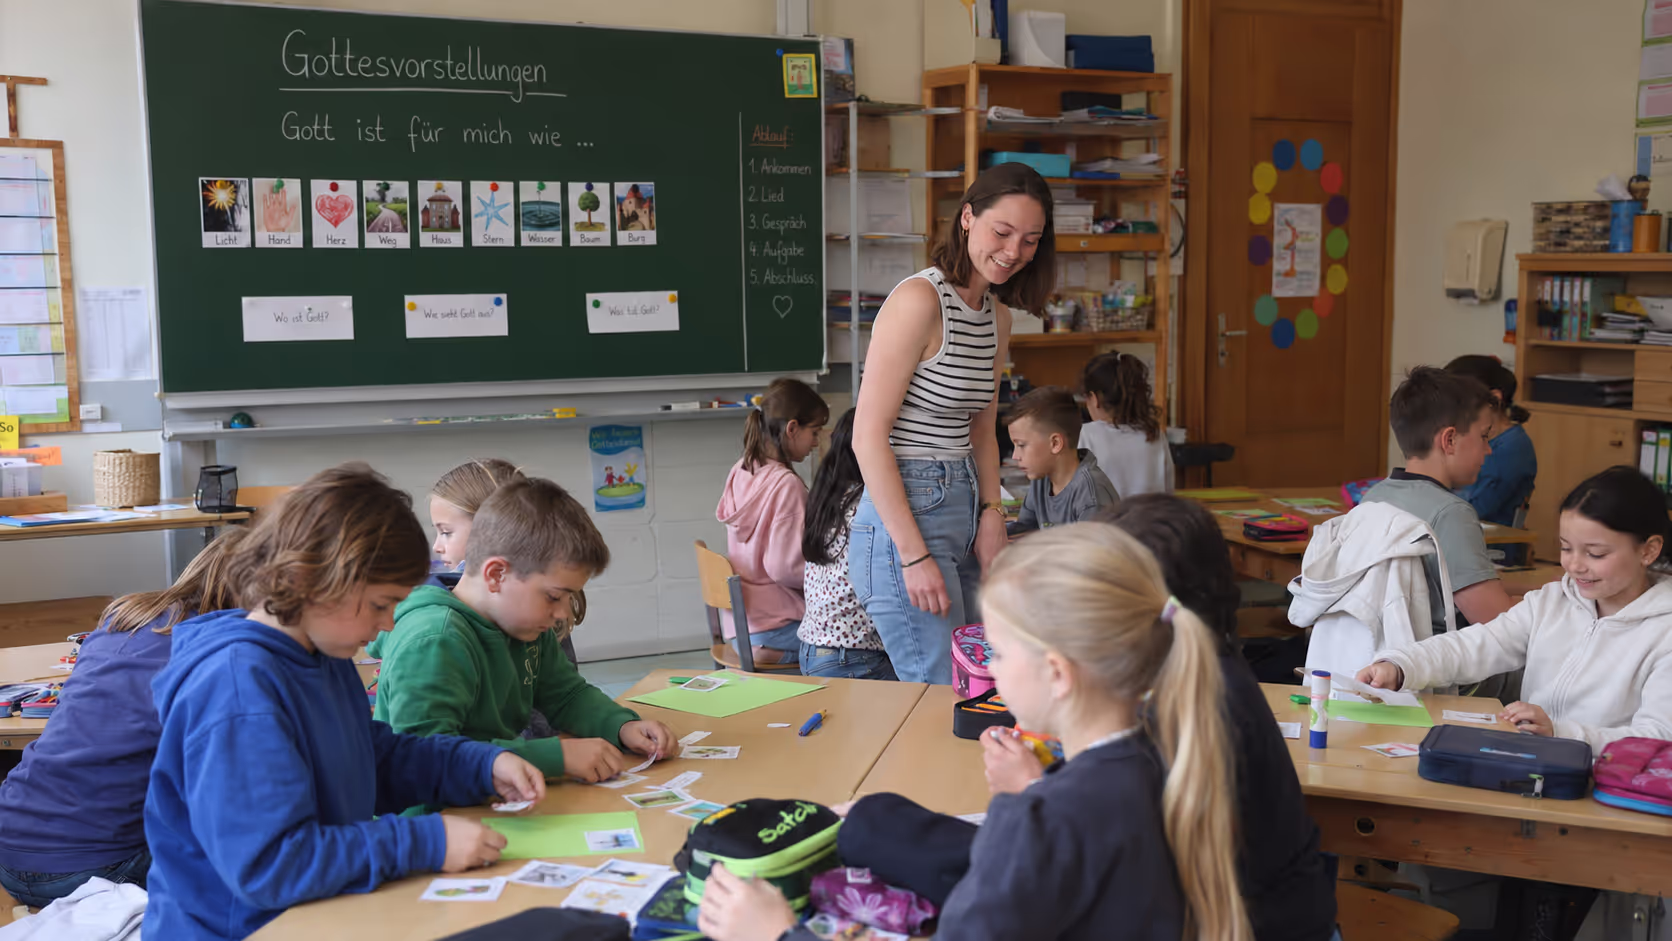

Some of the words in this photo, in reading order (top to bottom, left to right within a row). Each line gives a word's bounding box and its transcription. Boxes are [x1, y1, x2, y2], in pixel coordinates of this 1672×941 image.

[282, 29, 547, 103] Gottesvorstellungen
[281, 110, 336, 142] Gott
[356, 114, 387, 142] ist
[407, 115, 444, 152] für
[463, 115, 512, 145] mich
[528, 125, 562, 147] wie
[748, 157, 758, 174] 1.
[760, 157, 812, 175] Ankommen
[748, 186, 759, 202] 2.
[761, 185, 785, 203] Lied
[748, 213, 759, 230] 3.
[762, 213, 807, 236] Gespräch
[215, 234, 238, 246] Licht
[268, 234, 291, 245] Hand
[326, 234, 347, 245] Herz
[378, 235, 398, 248] Weg
[482, 234, 504, 245] Stern
[627, 233, 646, 245] Burg
[749, 241, 760, 257] 4.
[763, 240, 805, 265] Aufgabe
[750, 269, 761, 285] 5.
[274, 312, 288, 323] Wo
